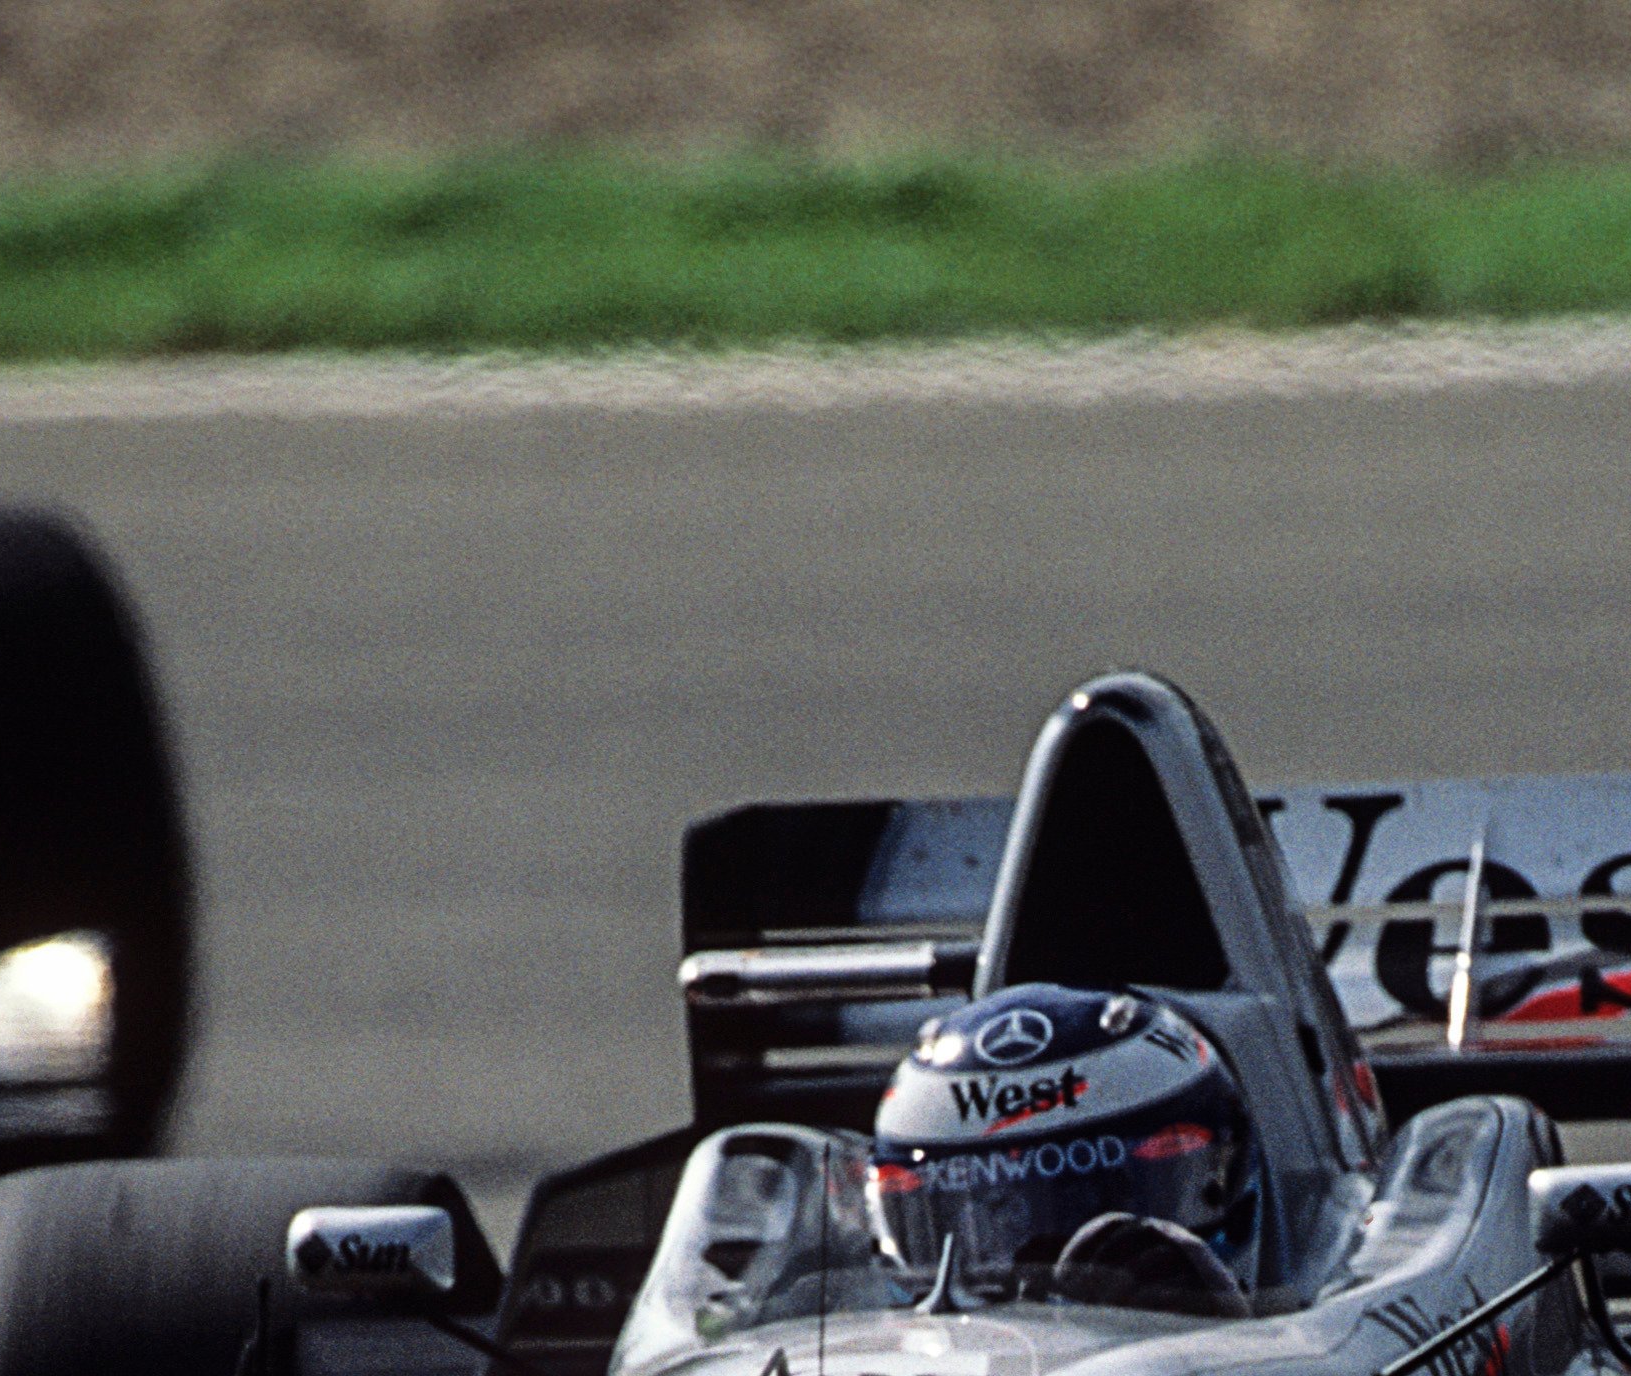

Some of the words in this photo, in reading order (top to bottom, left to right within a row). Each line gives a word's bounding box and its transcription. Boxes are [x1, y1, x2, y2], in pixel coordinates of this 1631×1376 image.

[949, 1066, 1086, 1122] West
[924, 1135, 1126, 1191] KENWOOD
[335, 1231, 411, 1273] Sun
